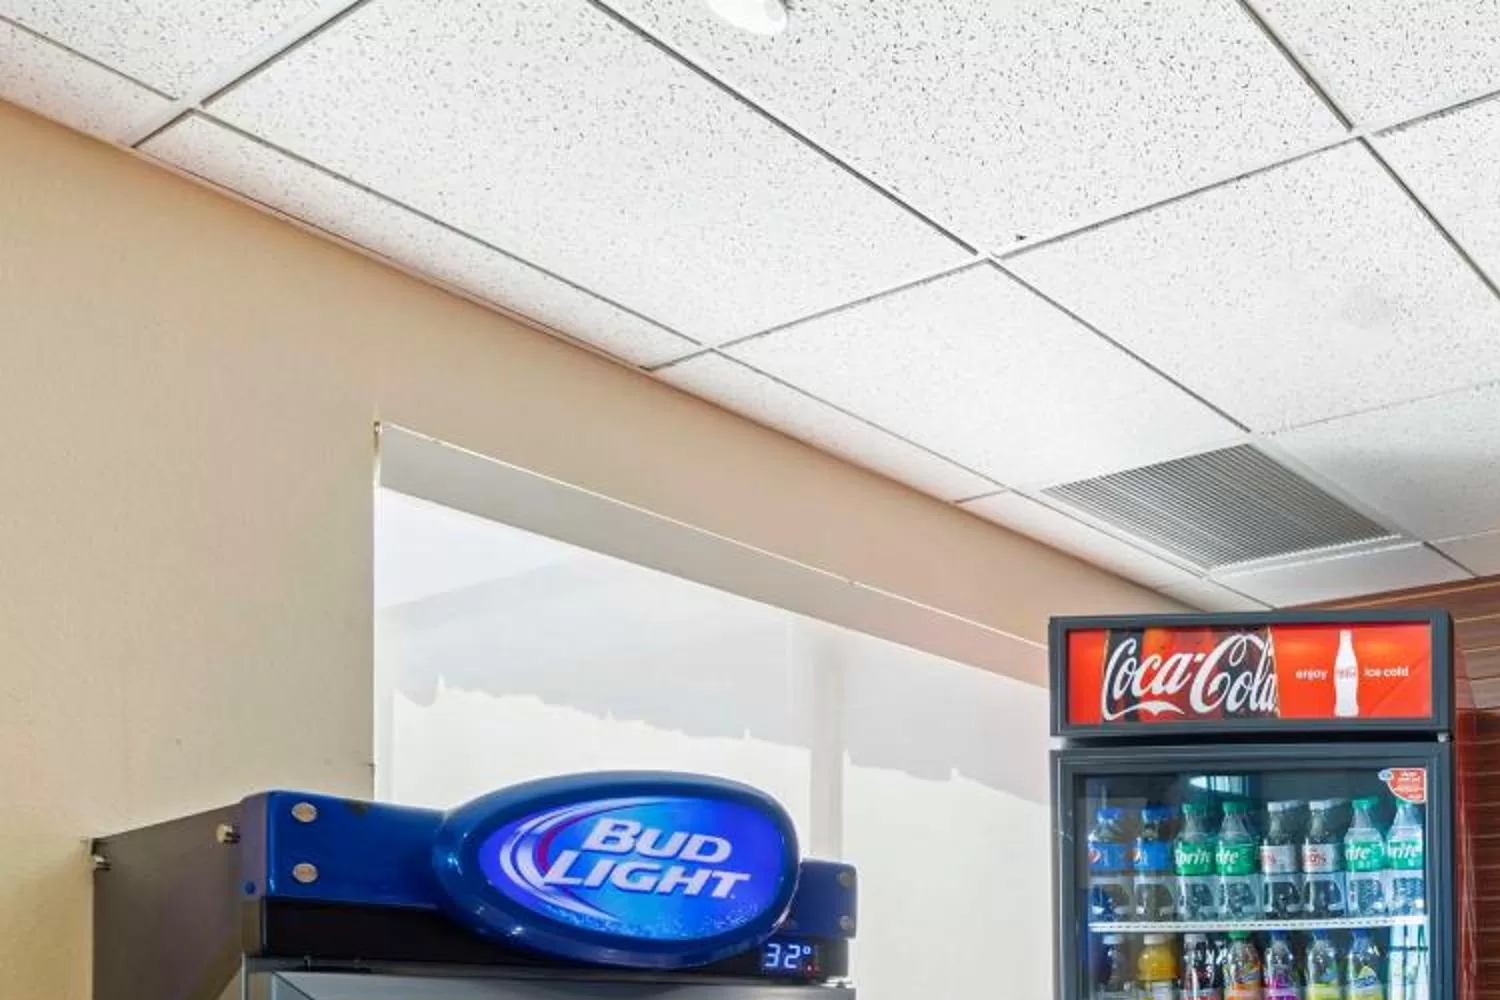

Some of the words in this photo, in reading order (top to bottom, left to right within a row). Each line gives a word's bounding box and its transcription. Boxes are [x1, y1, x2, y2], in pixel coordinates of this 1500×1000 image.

[1103, 633, 1279, 721] Coca-Cola
[1295, 667, 1328, 681] enjoy
[1364, 666, 1381, 678] ice
[1382, 665, 1410, 678] cold
[581, 817, 733, 864] BUD
[544, 851, 751, 899] LIGHT
